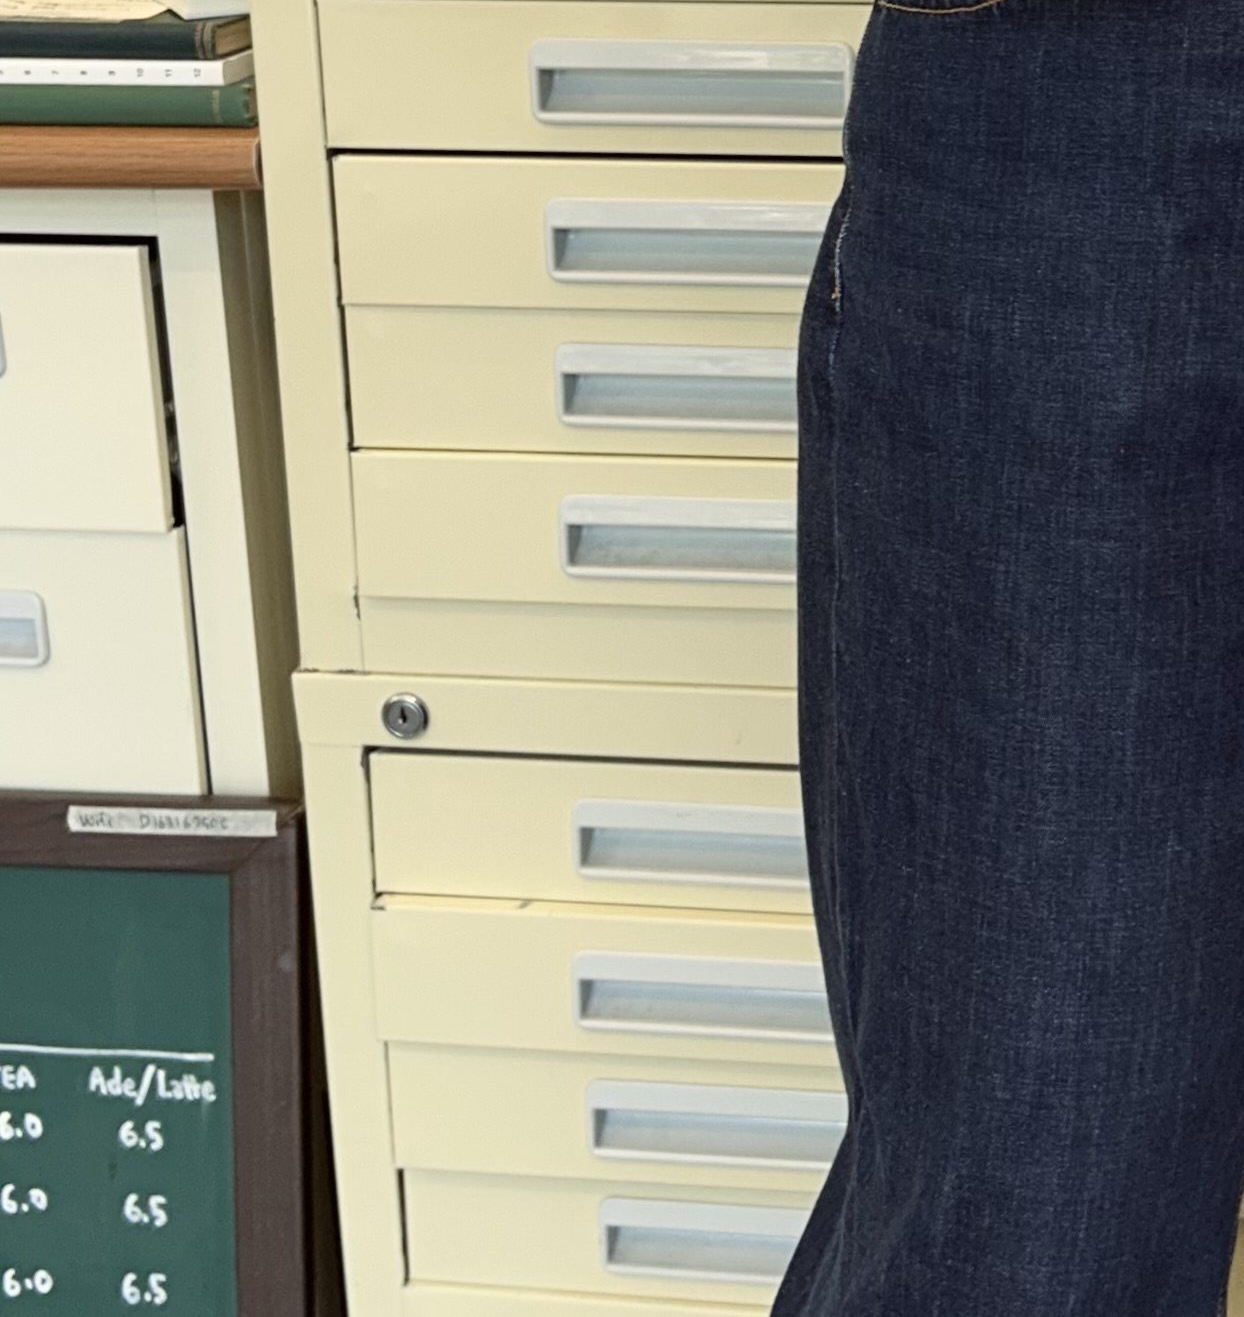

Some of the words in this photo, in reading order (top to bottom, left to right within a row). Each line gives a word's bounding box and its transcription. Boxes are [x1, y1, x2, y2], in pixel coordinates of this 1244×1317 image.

[0, 1064, 37, 1090] EA
[0, 1111, 44, 1140] 6.0
[118, 1120, 164, 1152] 6.5
[0, 1183, 48, 1214] 6.0
[123, 1193, 168, 1227] 6.5
[3, 1268, 53, 1298] 6.0
[121, 1272, 168, 1306] 6.5
